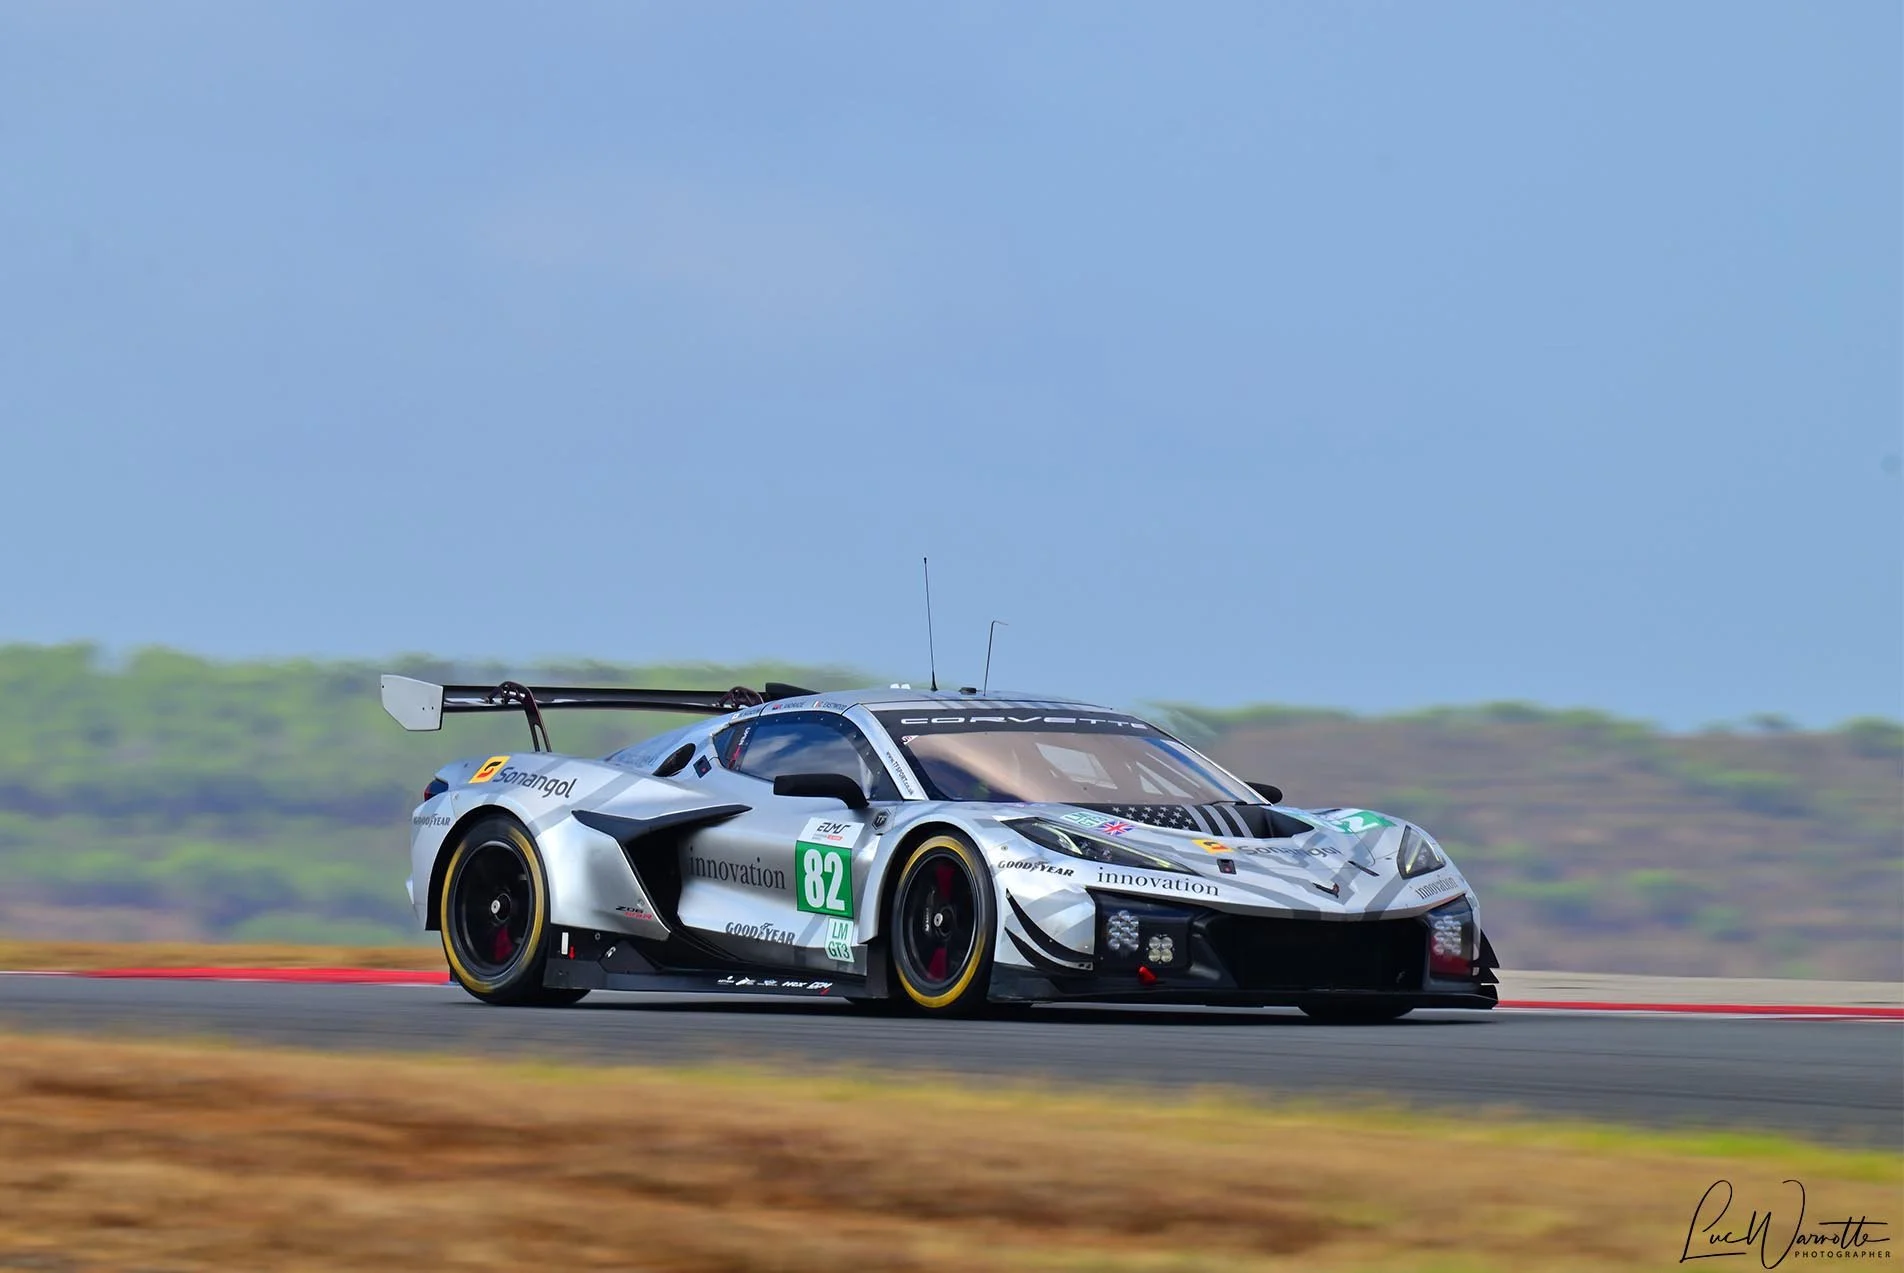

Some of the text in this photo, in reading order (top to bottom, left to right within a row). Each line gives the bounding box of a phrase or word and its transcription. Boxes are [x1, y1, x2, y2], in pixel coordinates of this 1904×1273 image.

[901, 716, 1148, 730] CORVETTE
[494, 766, 577, 798] Sonangol
[689, 846, 787, 890] innovation
[997, 860, 1075, 877] GOODYEAR
[803, 848, 846, 912] 82
[1097, 866, 1220, 896] innovation
[725, 922, 796, 945] GOODYEAR
[832, 922, 849, 940] LM
[828, 940, 850, 959] GT3
